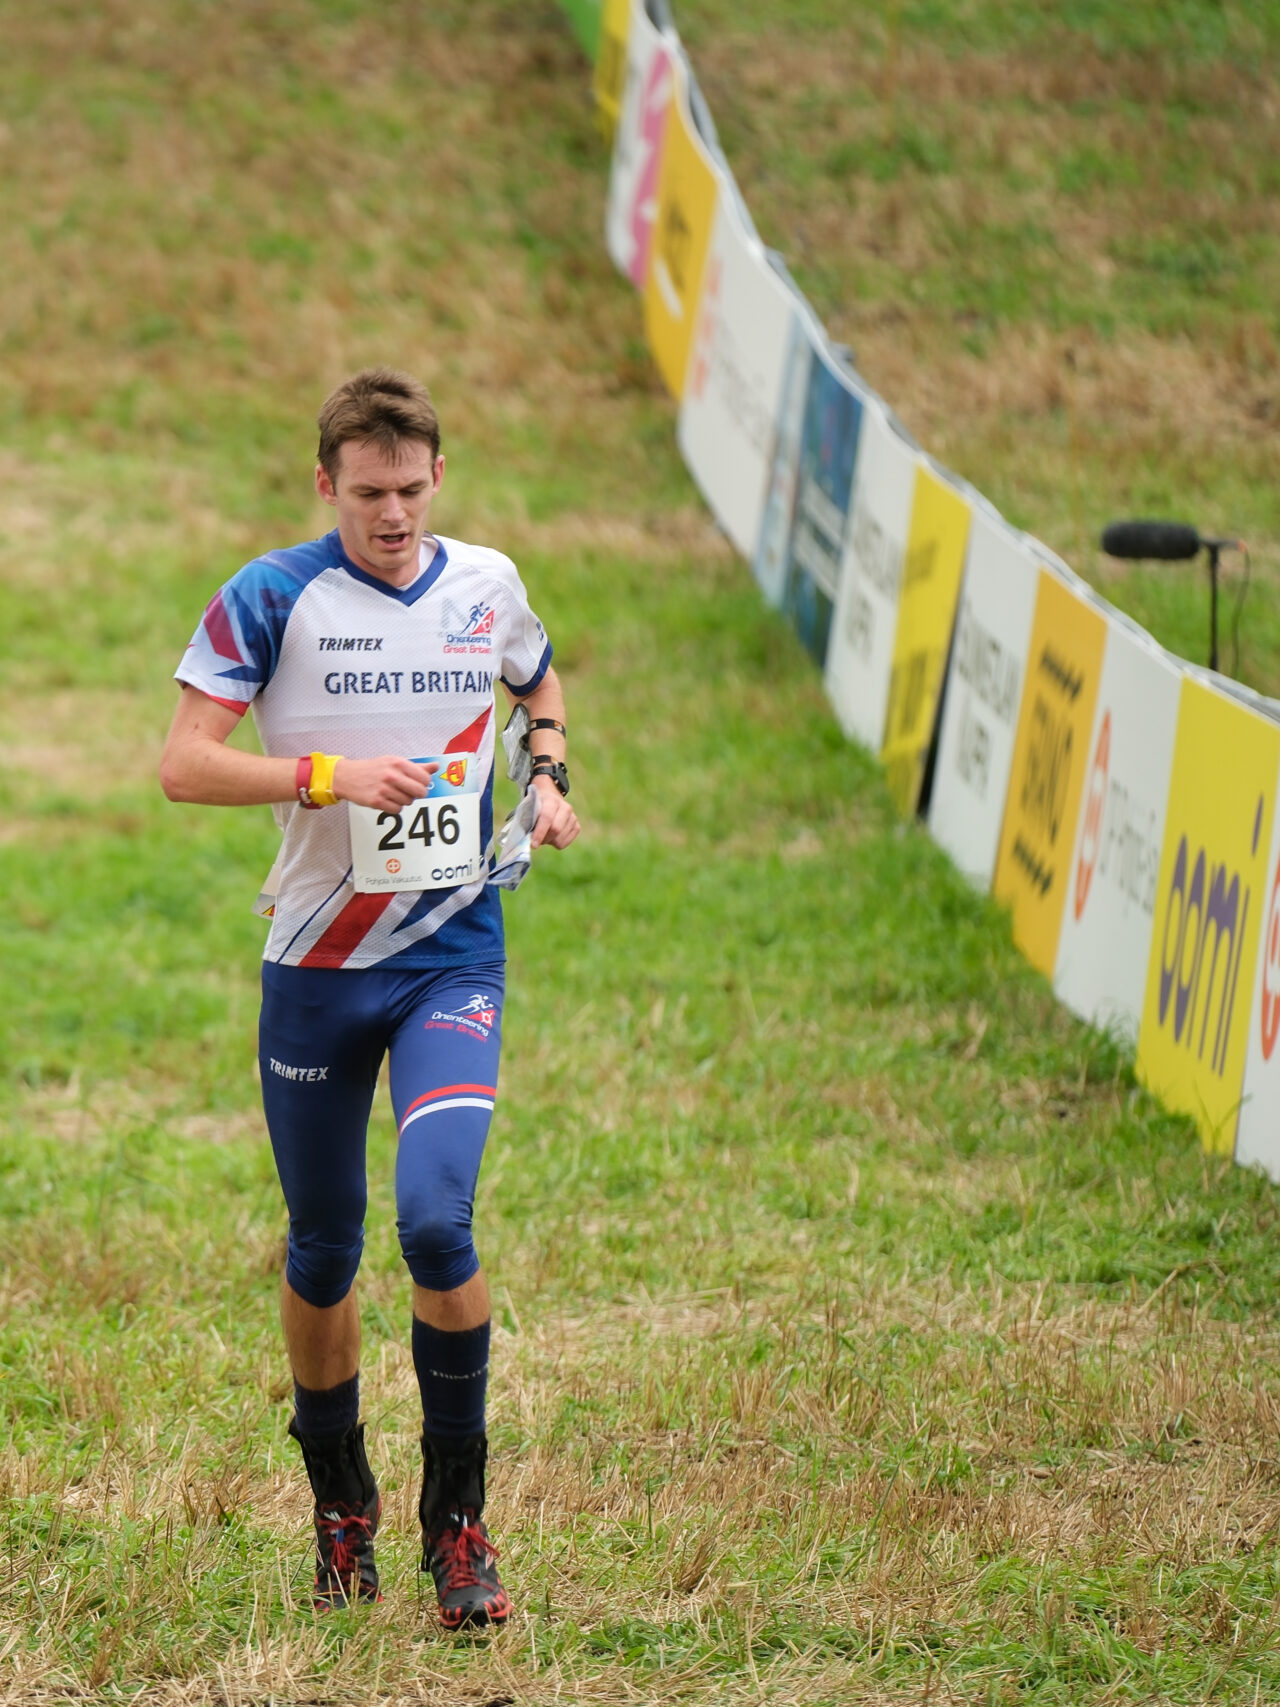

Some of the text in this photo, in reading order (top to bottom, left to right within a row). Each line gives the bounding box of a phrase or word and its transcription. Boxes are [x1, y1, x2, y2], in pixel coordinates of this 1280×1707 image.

[319, 637, 383, 651] TRIMTEX
[446, 633, 492, 646] Orienteering
[324, 671, 493, 694] GREAT BRITAIN
[376, 804, 460, 851] 246
[431, 859, 473, 881] oomi
[1158, 790, 1265, 1079] oomi
[424, 1020, 454, 1030] Great
[431, 1011, 489, 1037] Orienteering
[270, 1057, 329, 1082] TRIMTEX
